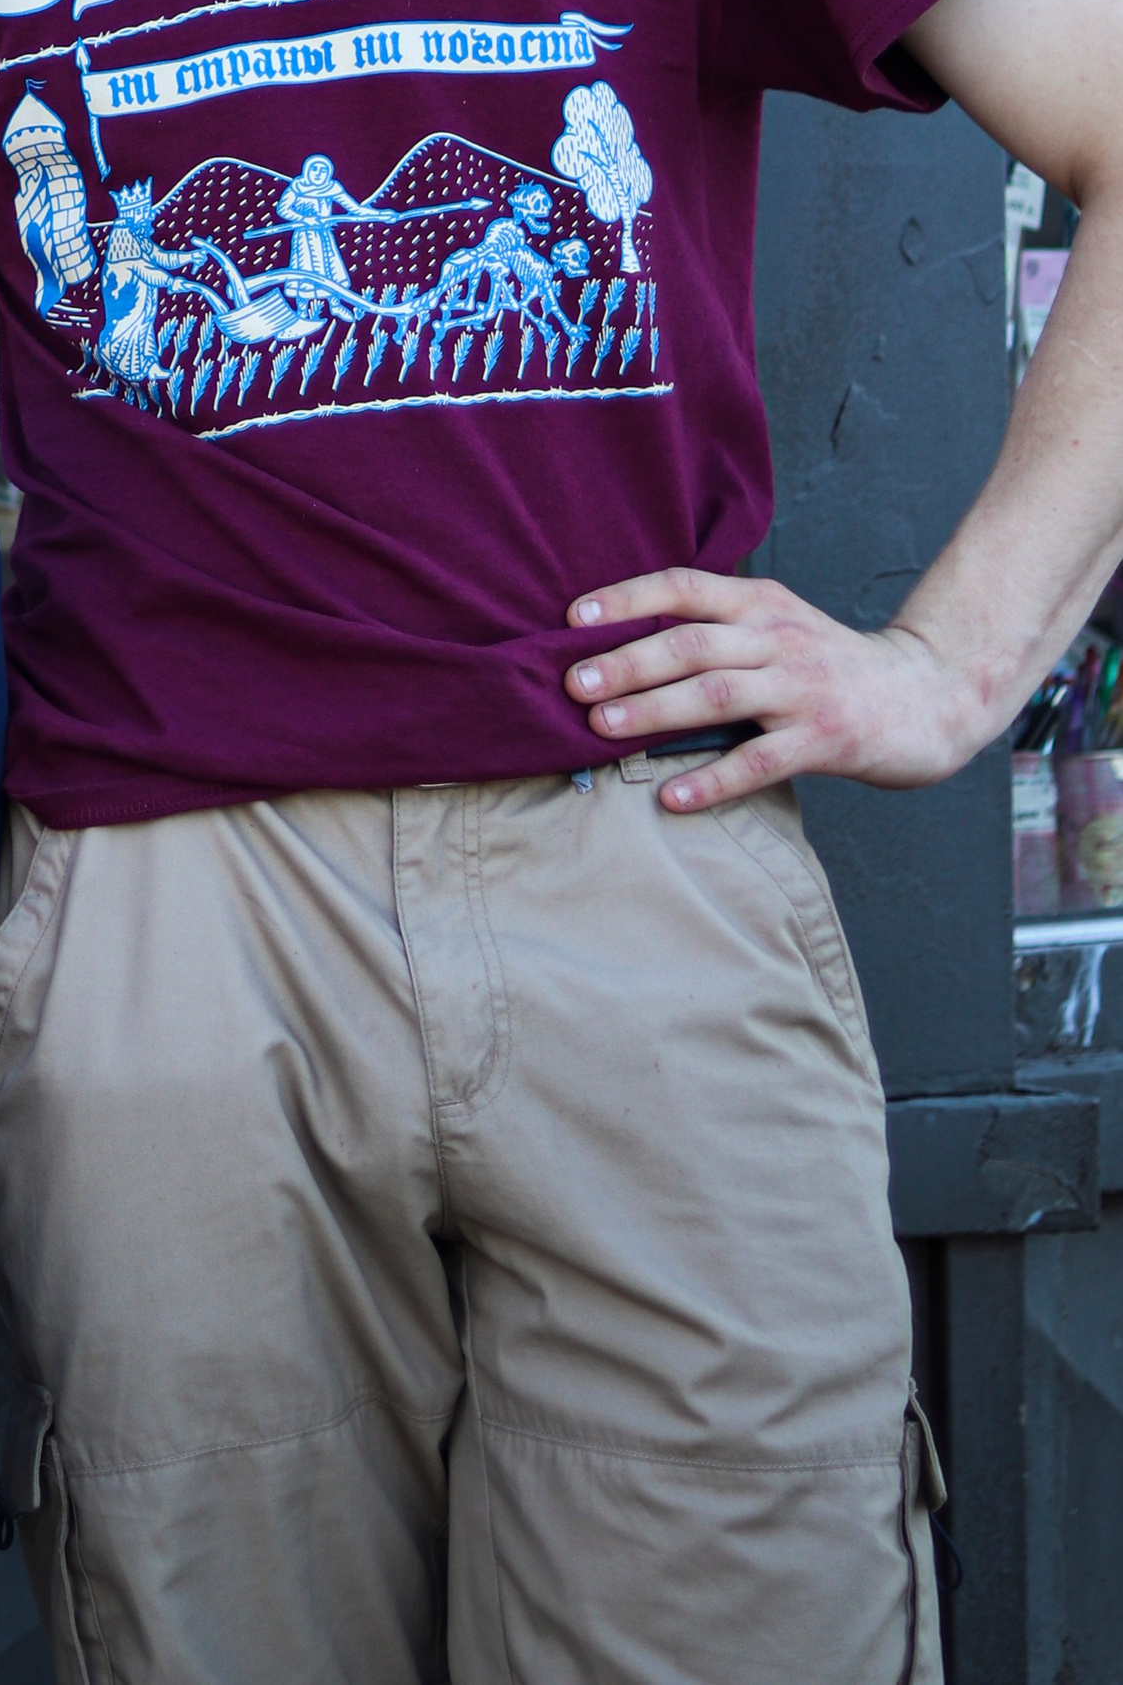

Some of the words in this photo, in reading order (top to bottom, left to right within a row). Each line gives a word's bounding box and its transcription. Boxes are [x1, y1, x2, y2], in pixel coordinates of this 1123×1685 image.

[107, 70, 161, 109] ни
[175, 39, 337, 97] страны
[351, 30, 403, 70] ни
[420, 27, 594, 66] погоста
